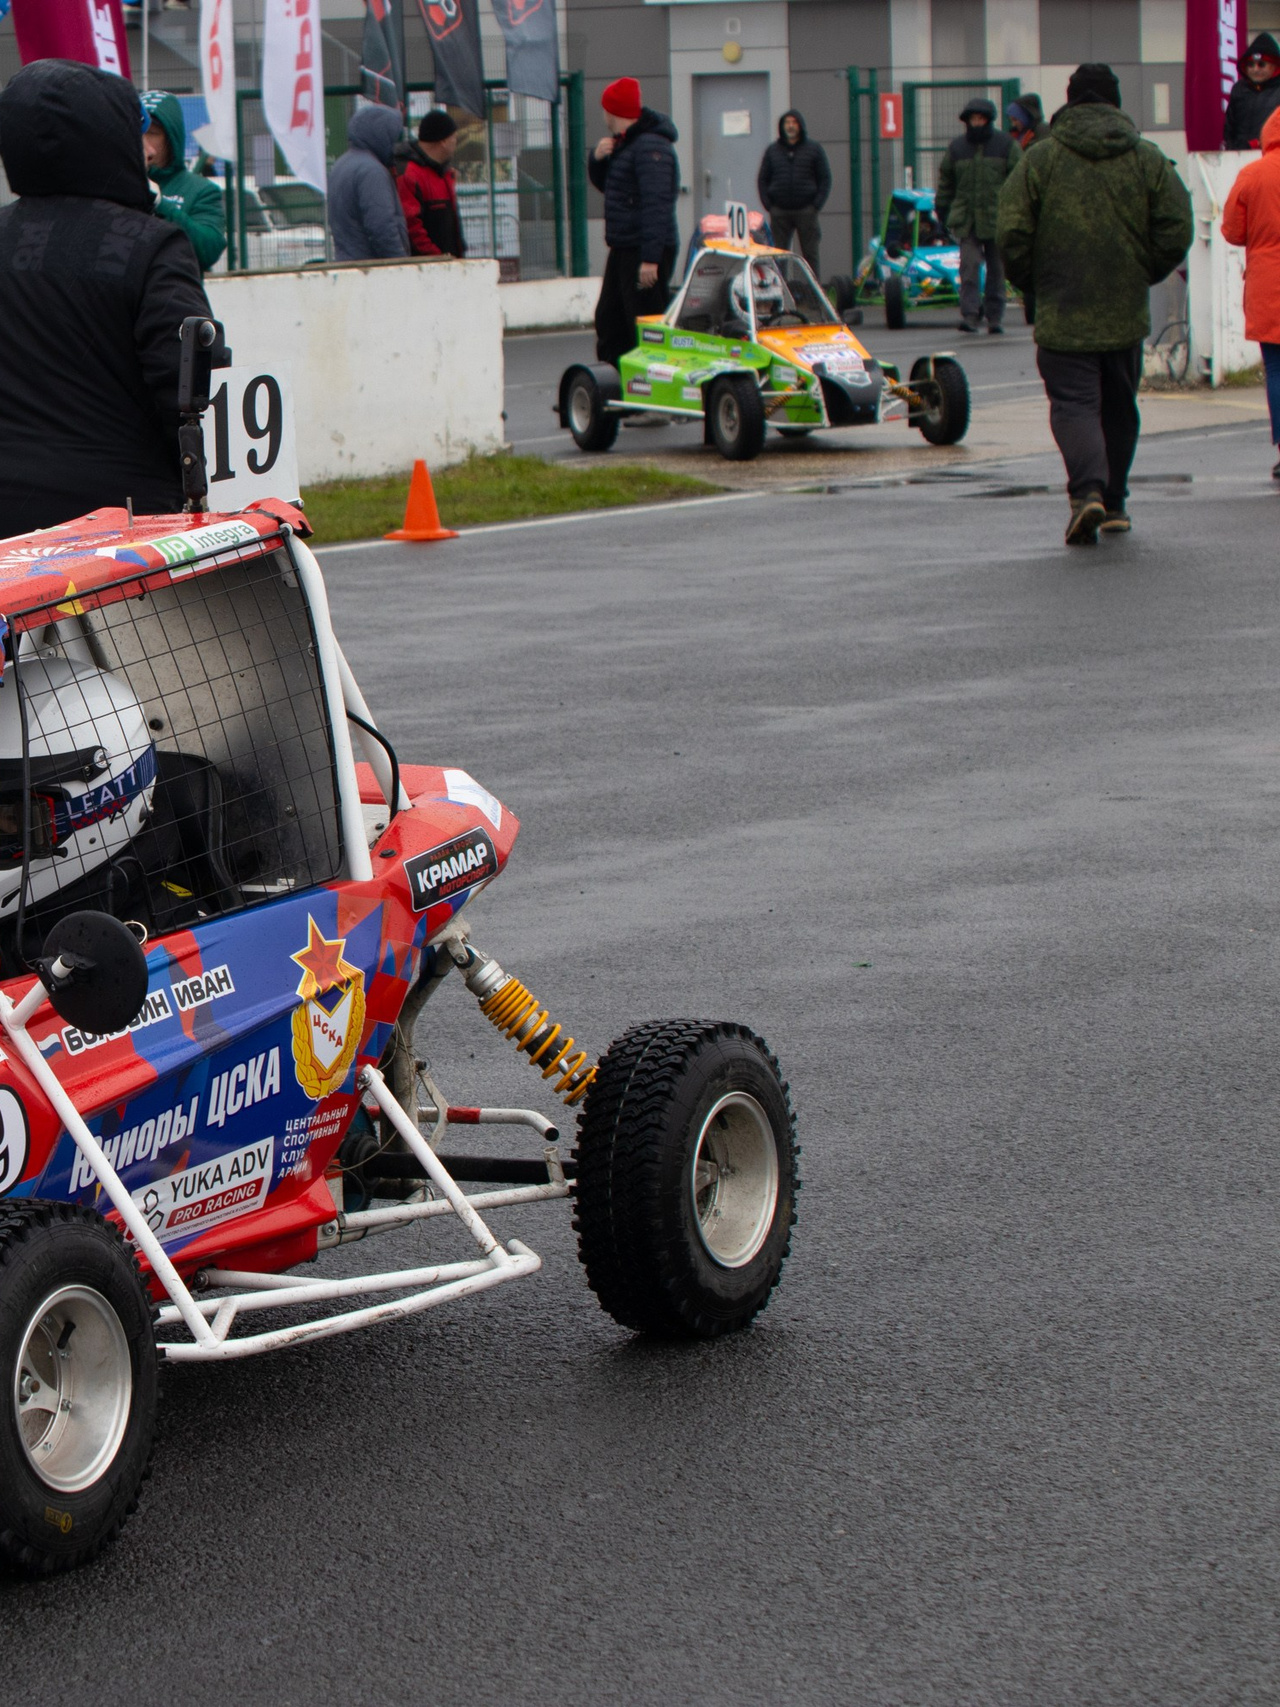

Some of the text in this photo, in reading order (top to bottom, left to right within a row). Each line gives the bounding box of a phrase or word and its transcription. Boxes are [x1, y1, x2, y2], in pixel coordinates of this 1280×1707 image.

[884, 100, 897, 132] 1
[727, 203, 746, 239] 10
[208, 374, 283, 483] 19
[192, 521, 254, 549] integra
[66, 764, 139, 820] LEATT
[416, 842, 488, 893] КРАМАР
[174, 968, 232, 1009] ИВАН
[313, 1014, 343, 1048] ЦСКА
[207, 1046, 280, 1128] ЦСКА
[283, 1121, 341, 1147] СПОРТИВНЫЙ
[285, 1103, 349, 1132] ЦЕНТРАЛЬНЫЙ
[171, 1144, 270, 1202] YUKA ADV
[277, 1160, 308, 1179] АРМИИ
[281, 1148, 306, 1163] КЛУБ
[173, 1182, 257, 1224] PRO RACING
